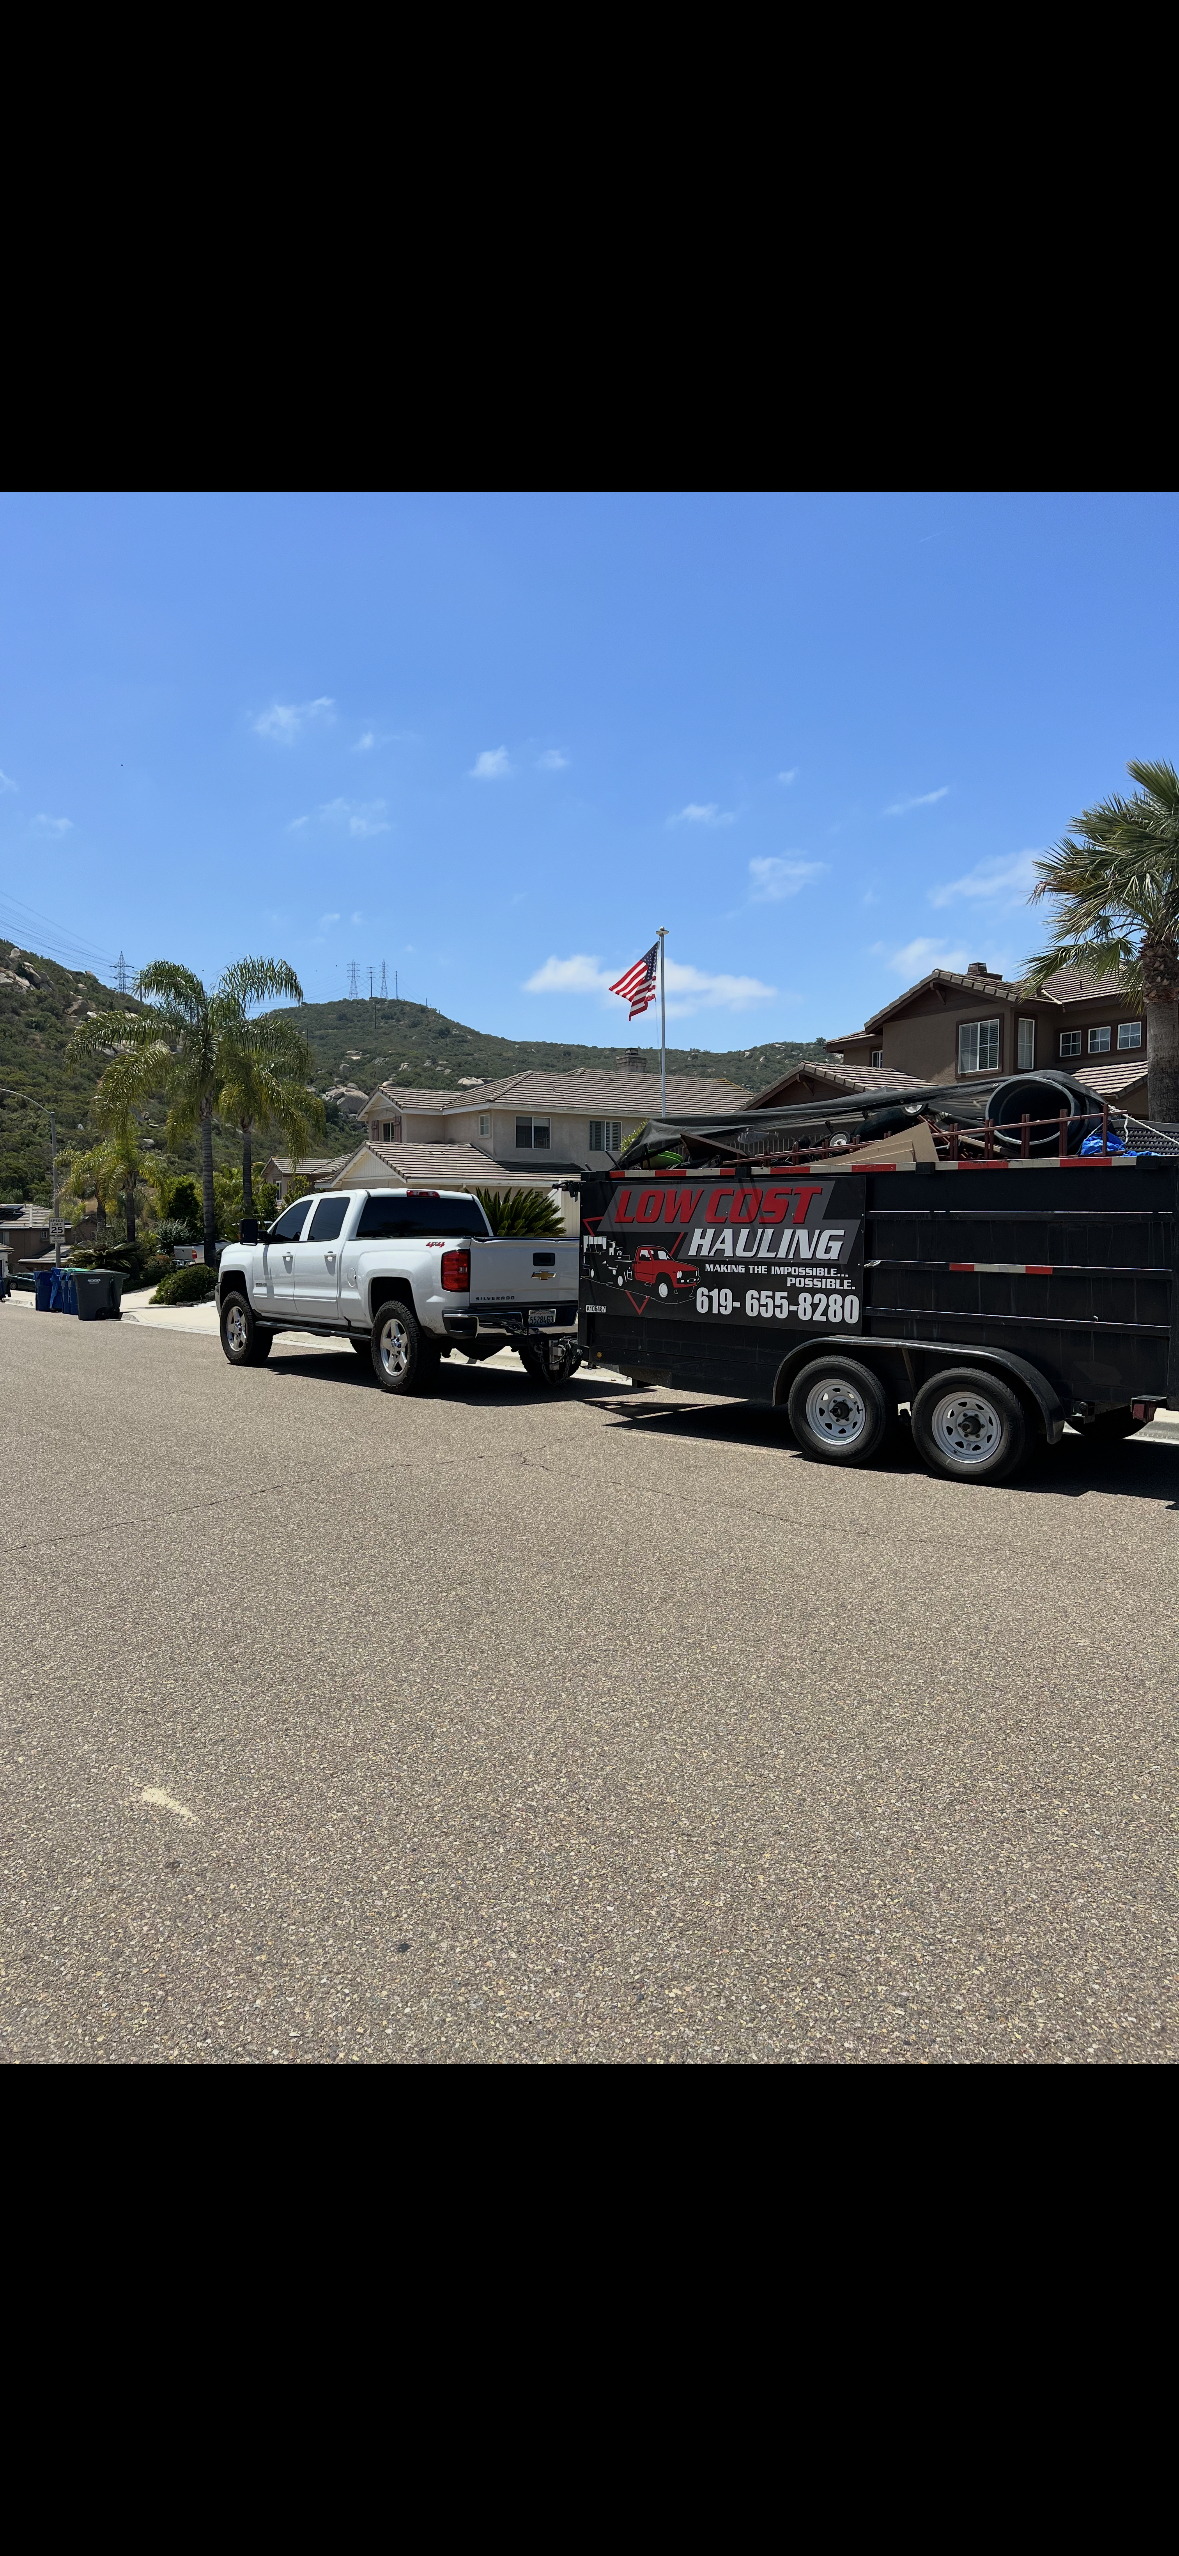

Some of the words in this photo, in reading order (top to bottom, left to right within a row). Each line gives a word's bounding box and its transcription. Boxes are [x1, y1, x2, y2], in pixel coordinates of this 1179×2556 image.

[614, 1189, 705, 1224] LOW
[705, 1186, 823, 1225] COST
[687, 1228, 846, 1261] HAULING
[704, 1263, 746, 1274] MAKING
[748, 1264, 768, 1274] THE
[770, 1265, 849, 1278] IMPOSSIBLE...
[786, 1276, 856, 1290] POSSIBLE.
[696, 1286, 741, 1316] 619-
[745, 1289, 860, 1325] 655-8280
